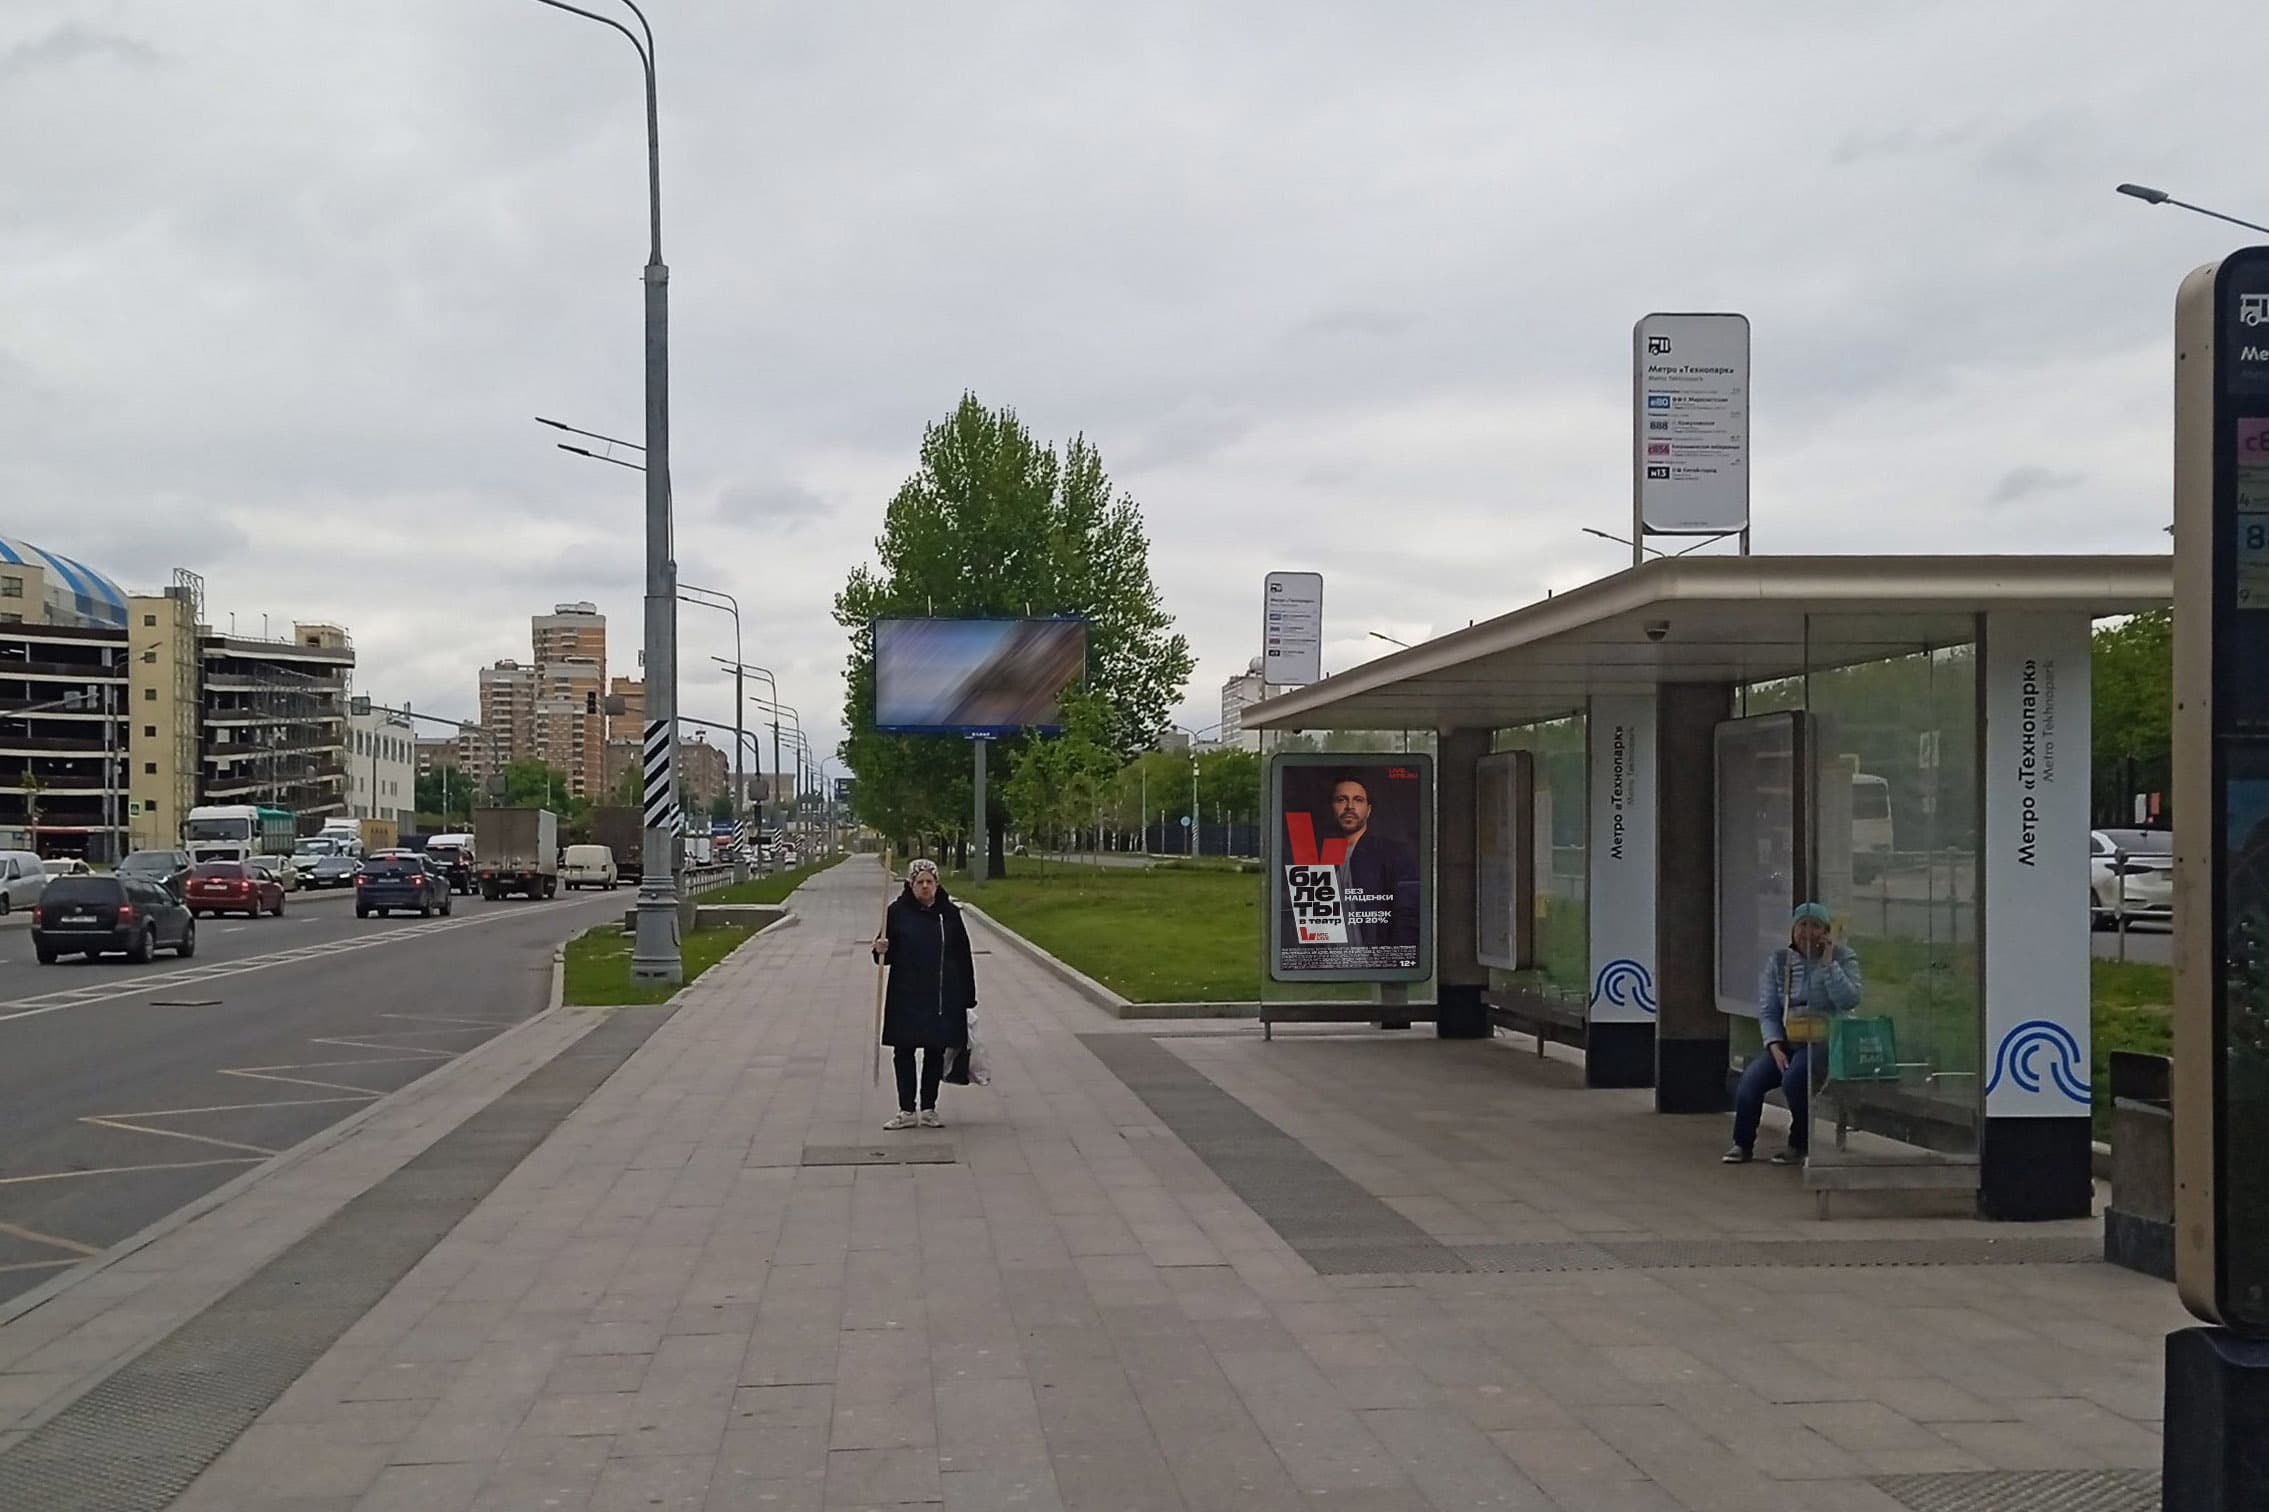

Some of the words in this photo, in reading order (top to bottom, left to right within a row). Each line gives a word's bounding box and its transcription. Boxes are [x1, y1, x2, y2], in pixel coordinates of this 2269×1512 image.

[1648, 365, 1677, 375] Метро
[2018, 659, 2040, 790] «Технопарк»
[1611, 725, 1625, 811] «Технопарк»
[2042, 741, 2055, 783] Metro
[1611, 814, 1625, 860] Метро
[2018, 796, 2039, 867] Метро
[1289, 865, 1331, 887] би
[1294, 886, 1336, 902] ле
[1344, 894, 1394, 902] НАЦЕНКИ
[1294, 901, 1341, 917] ты
[1348, 910, 1392, 918] КЕШБЭК
[1308, 918, 1342, 926] театр
[1347, 917, 1364, 925] ДО
